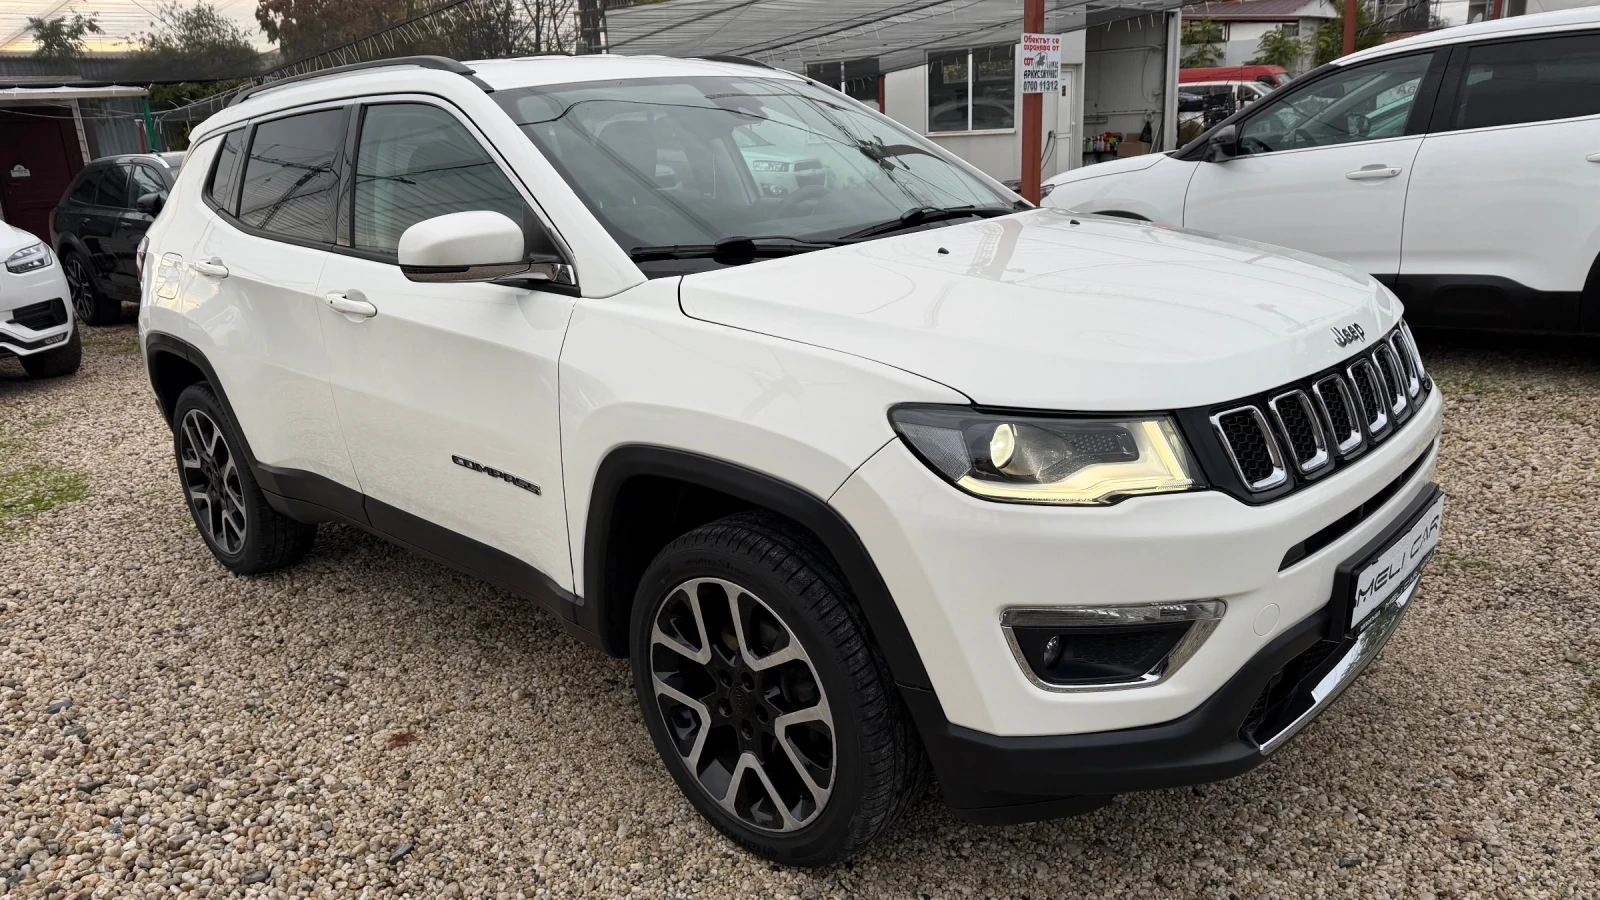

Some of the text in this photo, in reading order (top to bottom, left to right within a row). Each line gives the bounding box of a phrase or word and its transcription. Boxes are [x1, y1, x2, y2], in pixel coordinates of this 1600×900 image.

[1024, 35, 1050, 44] Обектът
[1024, 57, 1034, 66] СОТ
[1024, 81, 1058, 92] 0700 11312
[1330, 322, 1365, 348] Jeep
[451, 454, 541, 496] COMPASS
[1356, 514, 1440, 607] MELI CAR
